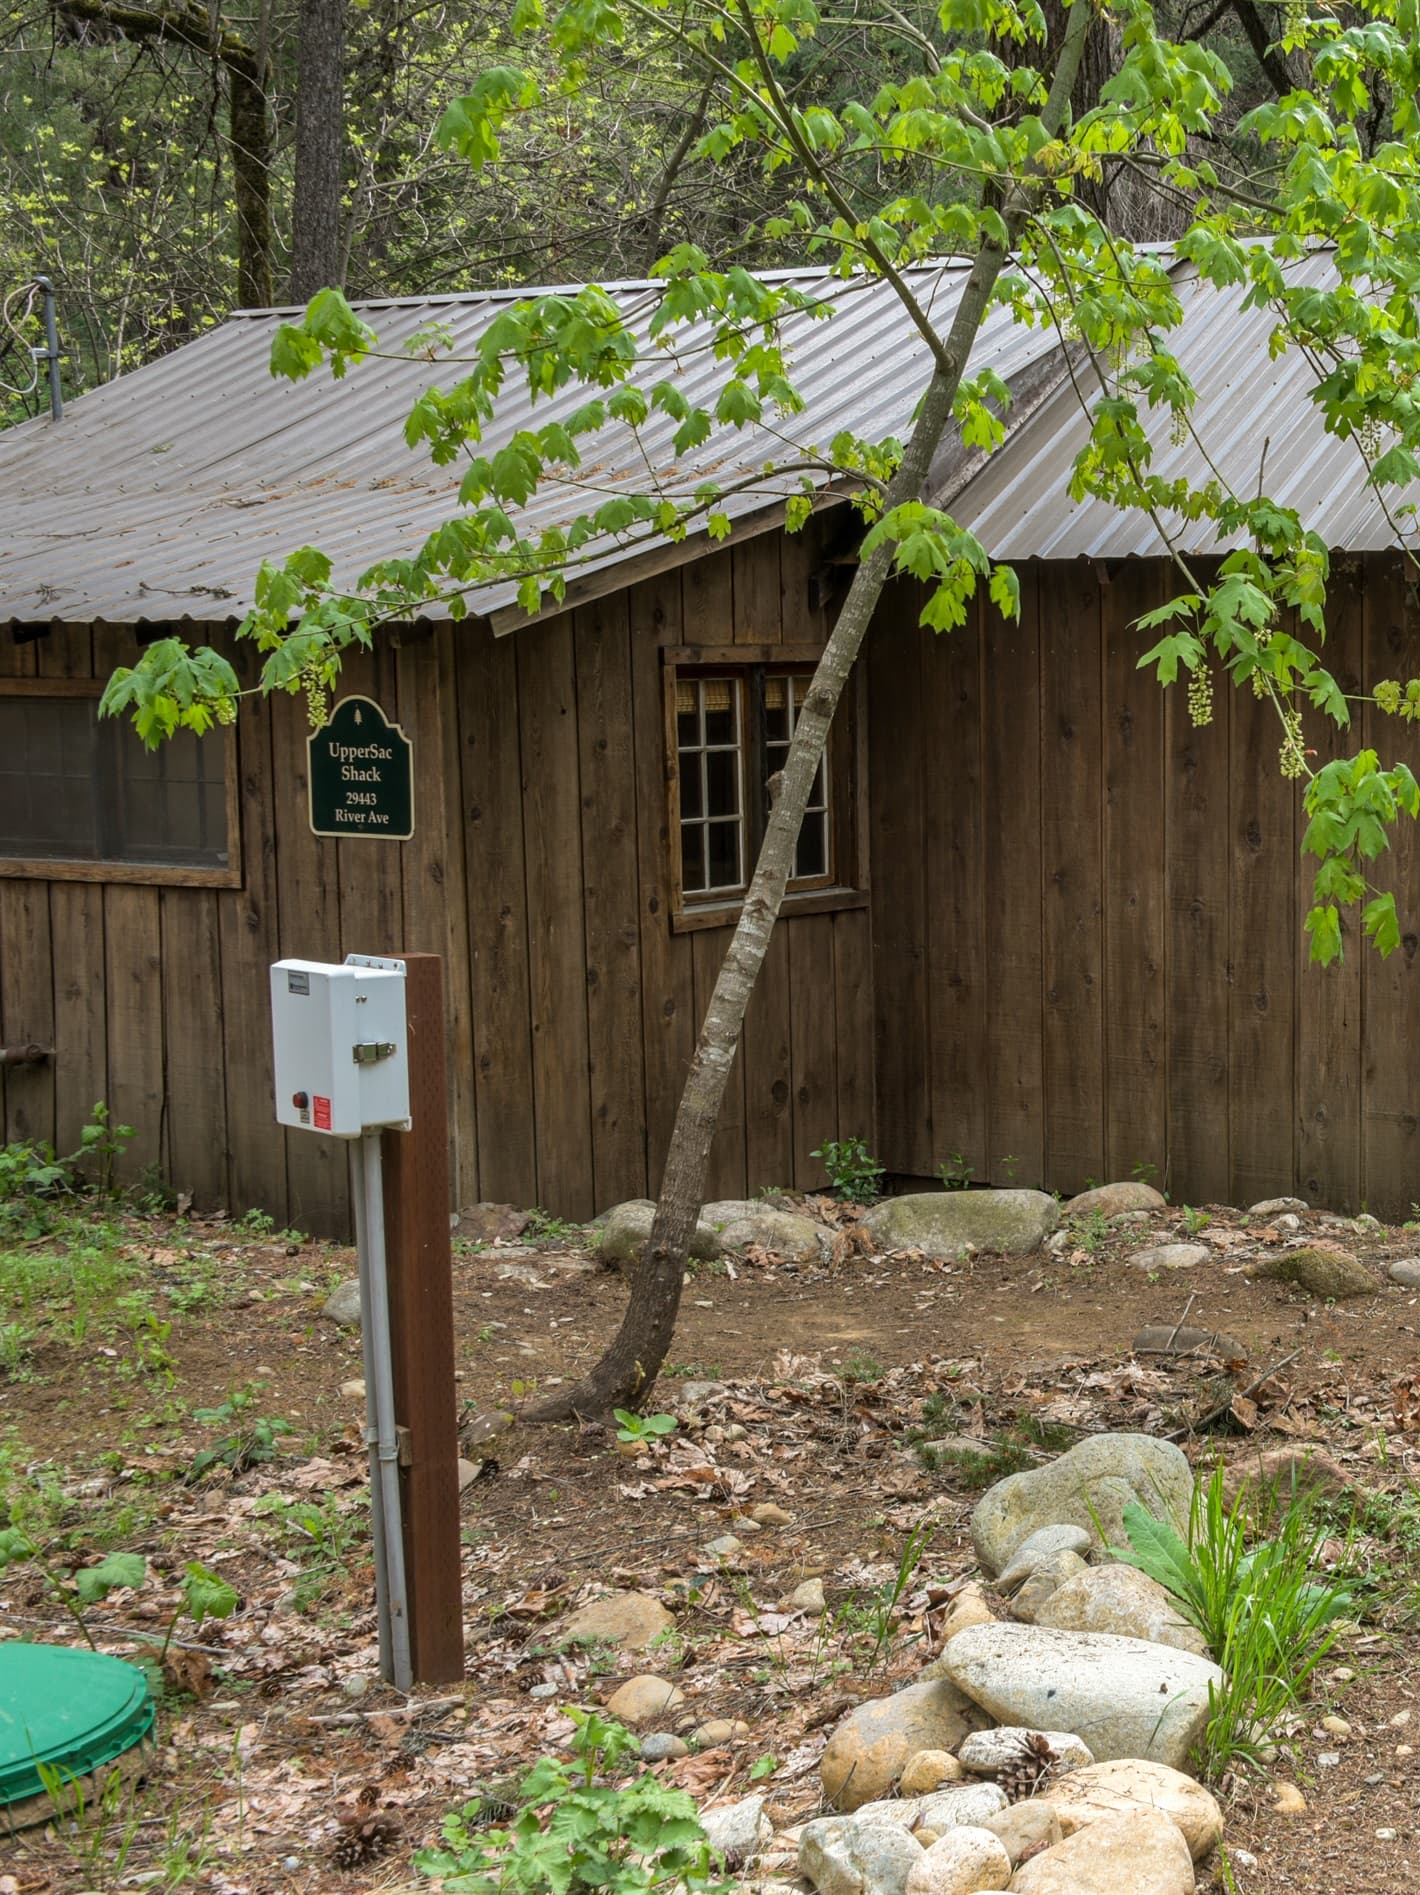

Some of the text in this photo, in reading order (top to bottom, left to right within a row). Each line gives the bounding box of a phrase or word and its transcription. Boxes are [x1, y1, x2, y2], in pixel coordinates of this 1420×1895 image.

[328, 742, 393, 762] UpperSac
[341, 765, 382, 782] Shack
[346, 792, 377, 806] 29443
[335, 809, 389, 824] River Ave
